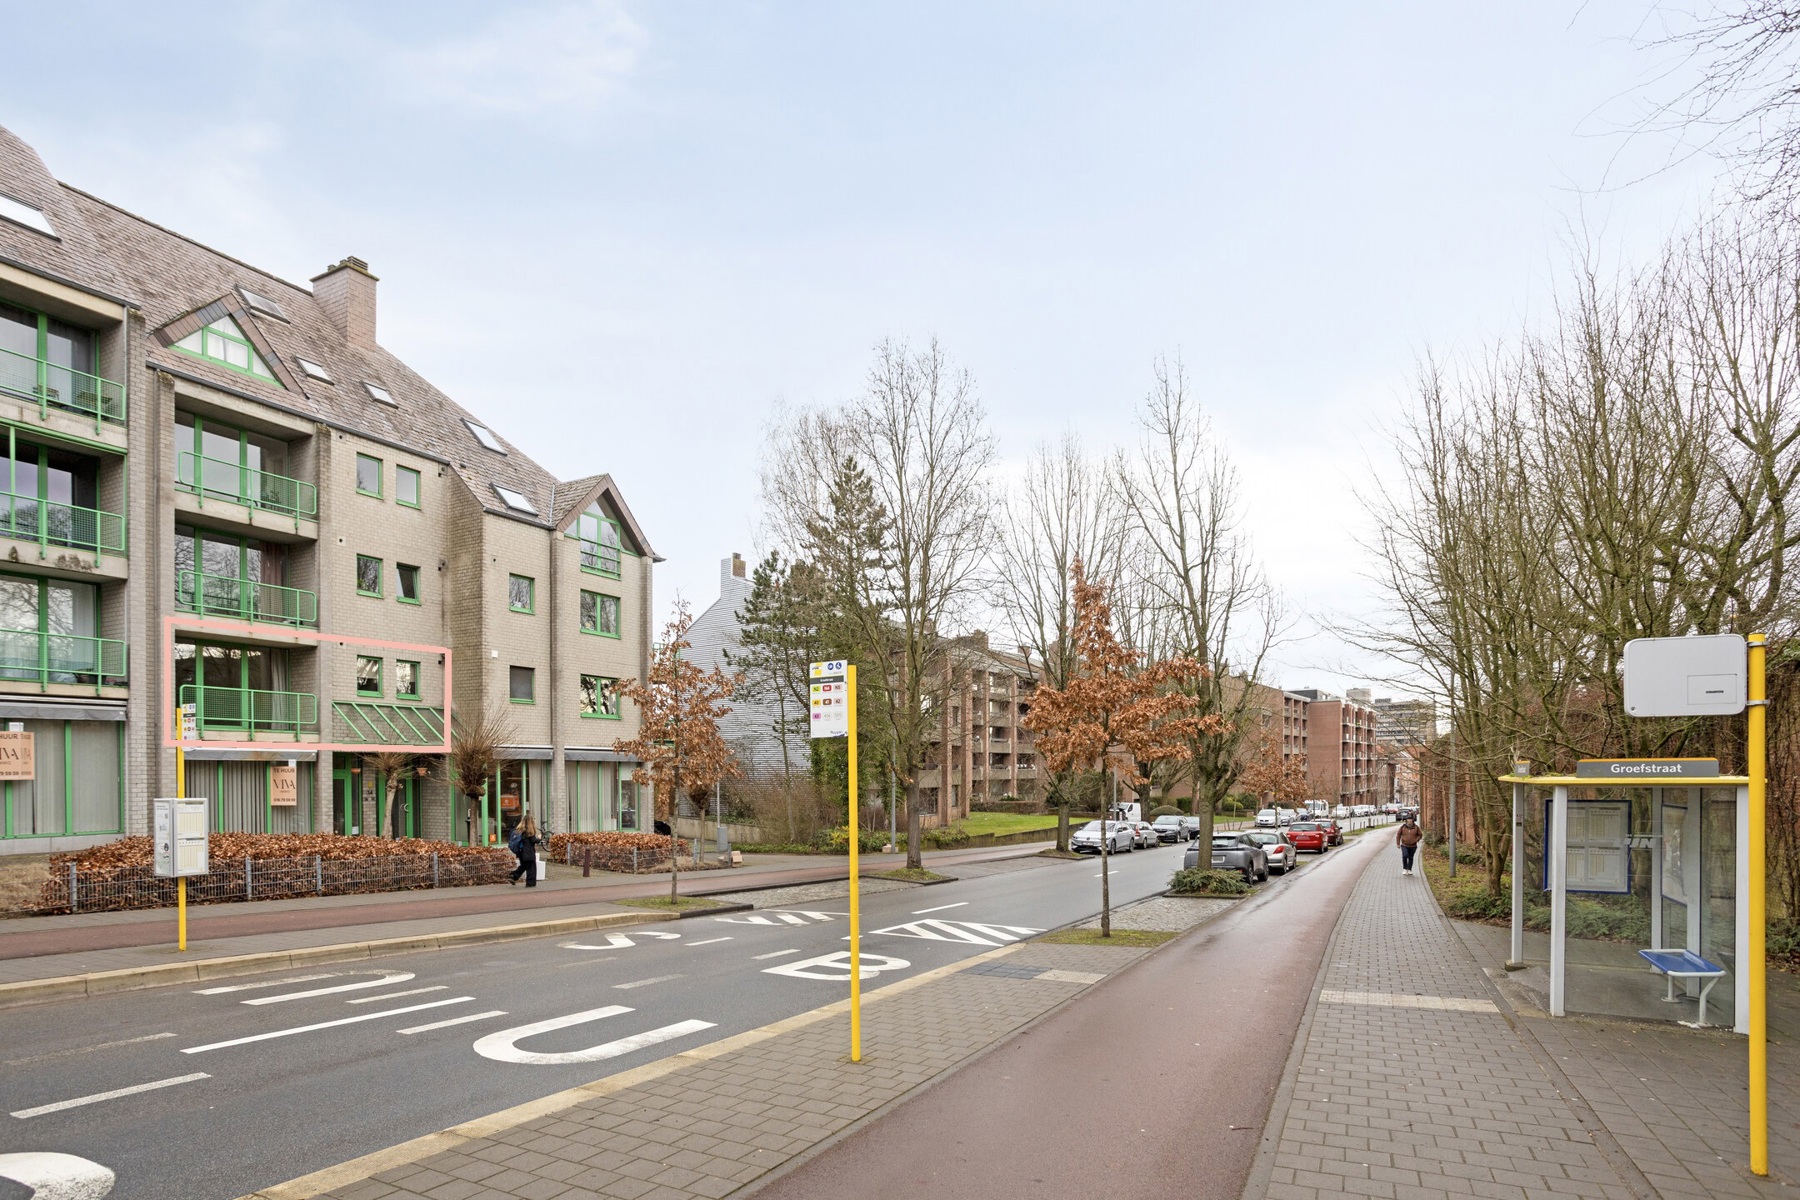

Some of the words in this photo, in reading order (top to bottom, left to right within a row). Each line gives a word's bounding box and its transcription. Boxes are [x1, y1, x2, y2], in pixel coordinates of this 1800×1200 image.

[0, 747, 19, 760] IVA
[1611, 763, 1682, 774] Groefstraat
[273, 779, 296, 790] VIVA
